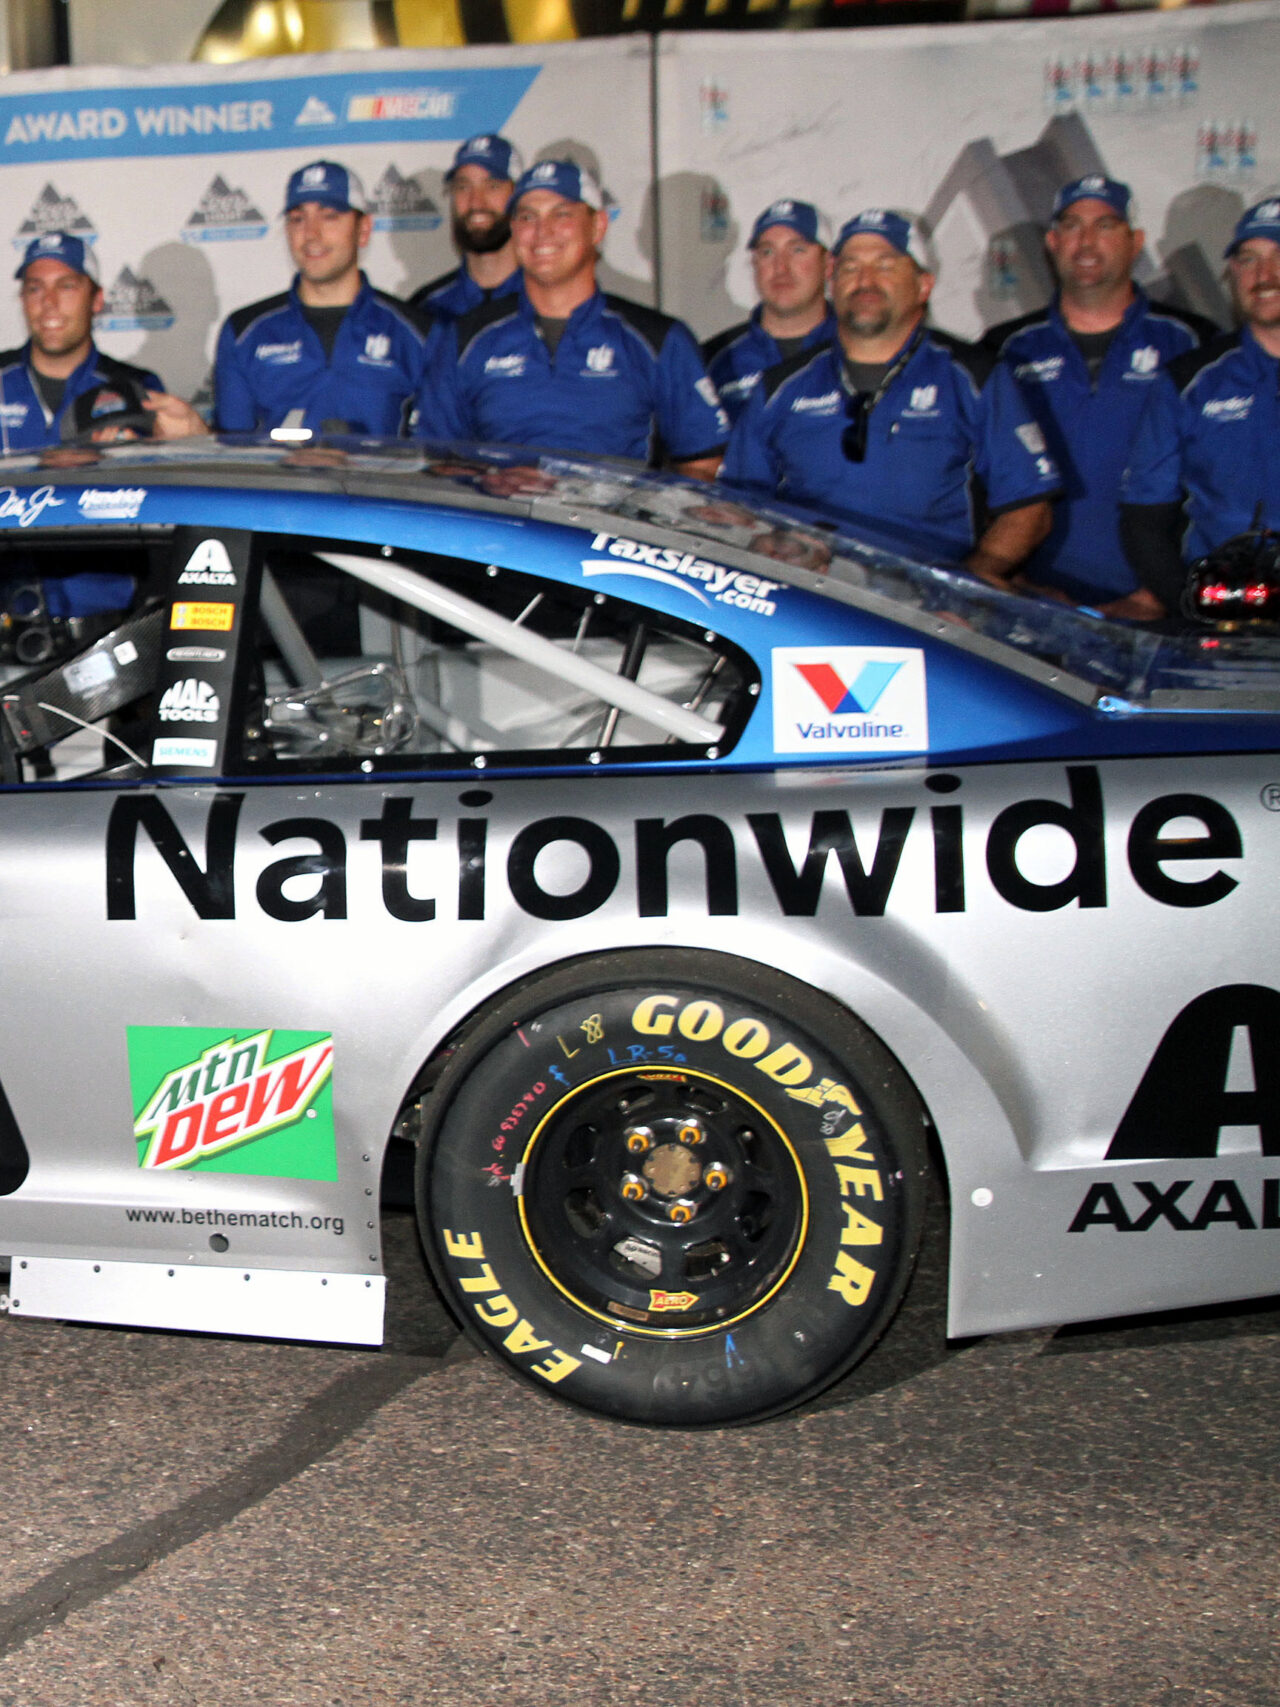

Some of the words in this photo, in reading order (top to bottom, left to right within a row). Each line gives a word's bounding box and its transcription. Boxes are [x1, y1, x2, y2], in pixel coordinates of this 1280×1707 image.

[4, 107, 128, 145] AWARD
[134, 99, 274, 138] WINNER
[590, 529, 779, 601] TaxSlayer
[177, 571, 237, 586] AXALTA
[192, 606, 228, 616] BOSCH
[715, 592, 777, 617] .com
[190, 617, 226, 626] BOSCH
[158, 678, 220, 710] MAC
[158, 708, 219, 723] TOOLS
[795, 721, 904, 740] Valvoline
[159, 746, 209, 758] SIEMENS
[105, 764, 1245, 923] Nationwide
[126, 1208, 345, 1236] www.bethematch.org
[443, 1228, 583, 1384] EAGLE
